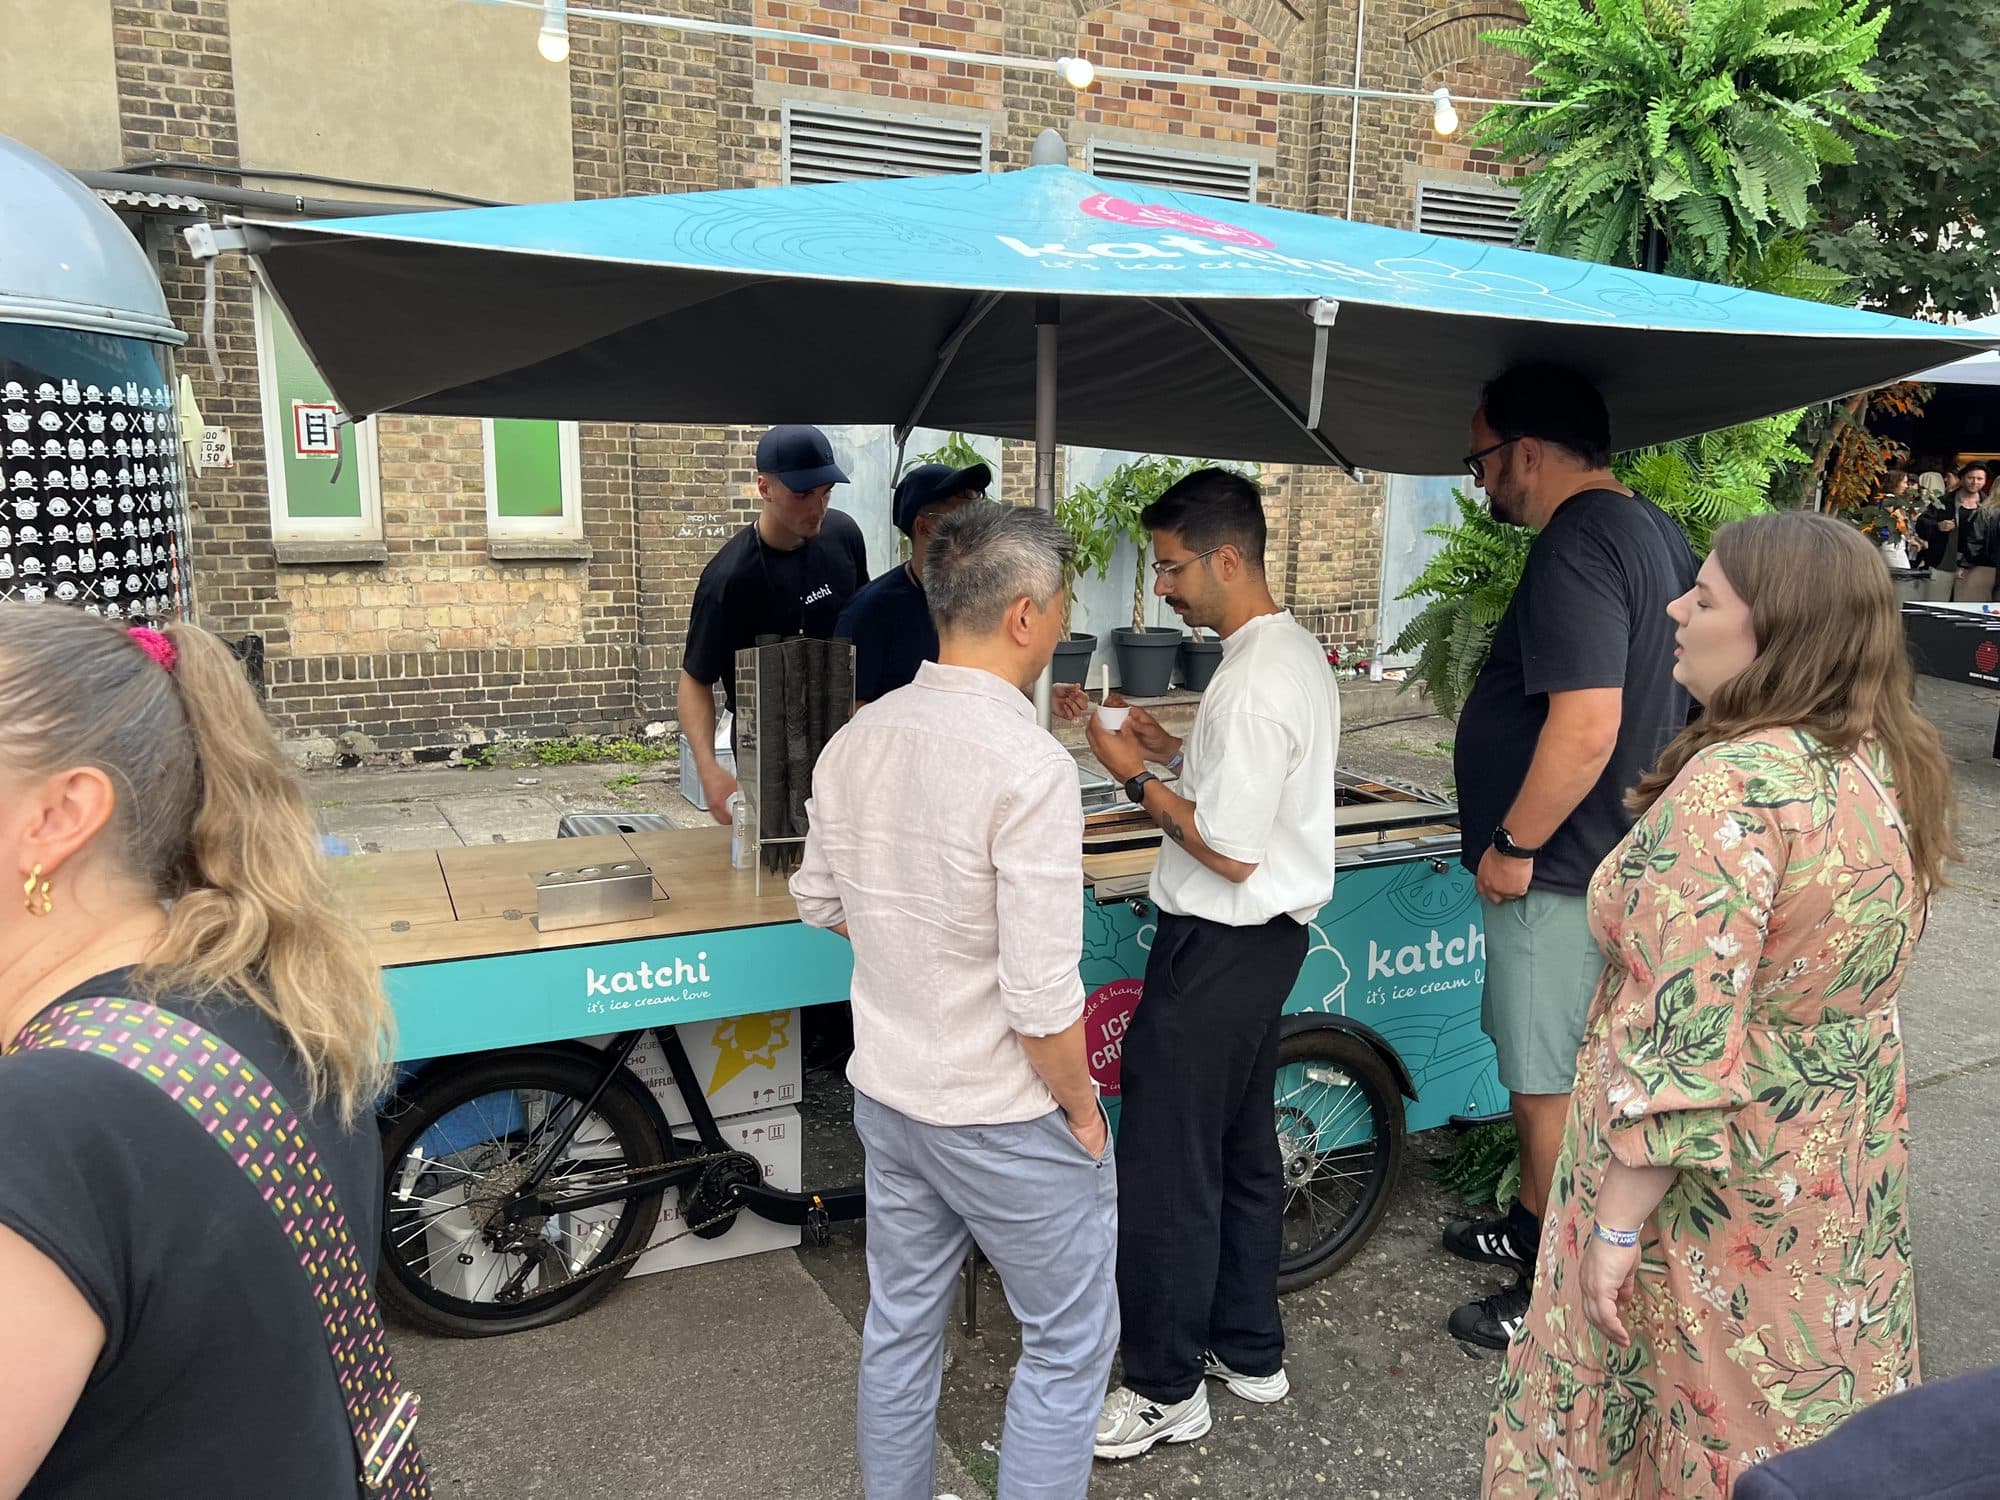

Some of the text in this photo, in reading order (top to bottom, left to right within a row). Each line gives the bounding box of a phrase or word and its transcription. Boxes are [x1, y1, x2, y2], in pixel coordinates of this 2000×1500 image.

[995, 234, 1397, 282] katchi
[1367, 923, 1486, 981] katch
[586, 951, 710, 997] katchi
[1392, 985, 1417, 1000] ice
[1420, 976, 1471, 995] cream
[610, 999, 632, 1010] ice
[634, 995, 681, 1008] cream
[682, 989, 711, 1001] love
[1137, 1404, 1166, 1428] N
